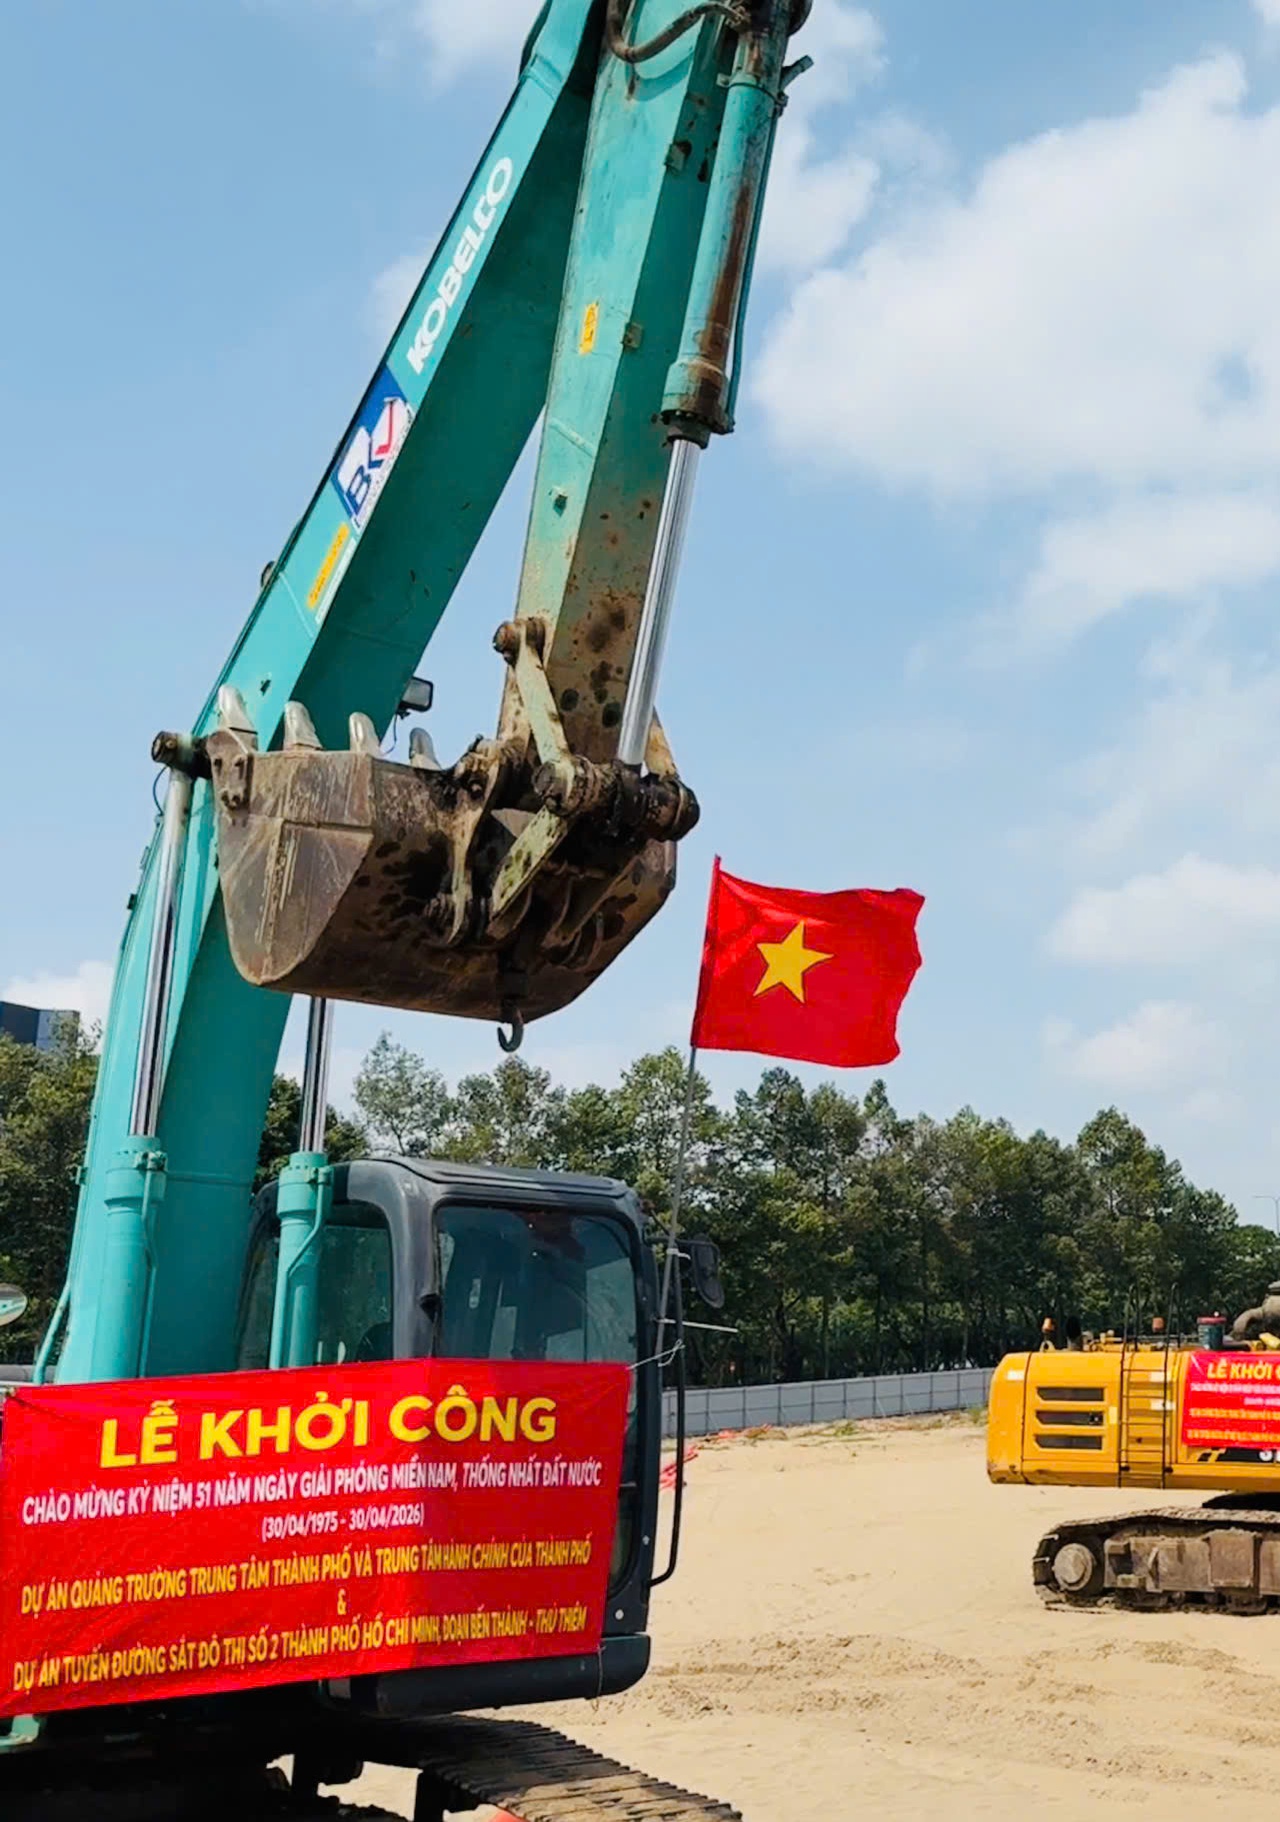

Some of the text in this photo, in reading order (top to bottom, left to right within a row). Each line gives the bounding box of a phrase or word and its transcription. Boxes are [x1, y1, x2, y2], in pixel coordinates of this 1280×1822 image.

[406, 157, 513, 375] KOBELCO
[100, 1384, 557, 1468] LỄ KHỞI CÔNG
[22, 1488, 70, 1525] CHÀO
[73, 1484, 125, 1519] MỪNG
[152, 1477, 193, 1517] NIỆM
[195, 1482, 212, 1508] 51
[214, 1472, 250, 1505] NĂM
[254, 1468, 298, 1502] NGÀY
[300, 1463, 332, 1498] GIẢI
[334, 1460, 389, 1494] PHÓNG
[391, 1453, 426, 1489] MIỀN
[428, 1462, 458, 1492] NAM,
[463, 1453, 506, 1488] THỐNG
[508, 1453, 541, 1488] NHẤT
[542, 1453, 568, 1487] ĐẤT
[568, 1456, 602, 1487] NƯỚC
[261, 1511, 338, 1542] (30/04/1975
[349, 1503, 424, 1531] 30/04/2026)
[21, 1582, 45, 1619] DỰ
[46, 1577, 67, 1610] ÁN
[70, 1571, 123, 1608] QUẢNG
[125, 1565, 187, 1602] TRƯỜNG
[189, 1565, 237, 1596] TRUNG
[240, 1555, 270, 1590] TÂM
[272, 1551, 319, 1586] THÀNH
[322, 1543, 352, 1581] PHỐ
[354, 1543, 372, 1577] VÀ
[375, 1545, 419, 1575] TRUNG
[421, 1538, 442, 1570] TÂM
[472, 1535, 510, 1569] CHÍNH
[510, 1534, 533, 1567] CỦA
[535, 1535, 569, 1566] THÀNH
[569, 1531, 592, 1565] PHỐ
[337, 1588, 347, 1615] &
[13, 1658, 37, 1695] DỰ
[38, 1652, 60, 1687] ÁN
[63, 1643, 109, 1683] TUYẾN
[112, 1641, 166, 1679] ĐƯỜNG
[169, 1634, 196, 1671] SẮT
[198, 1633, 220, 1668] ĐÔ
[223, 1636, 246, 1669] THỊ
[247, 1623, 270, 1663] SỐ
[270, 1634, 279, 1660] 2
[281, 1623, 328, 1659] THÀNH
[331, 1613, 361, 1651] PHỐ
[385, 1611, 409, 1647] CHÍ
[491, 1604, 528, 1637] THÀNH
[536, 1602, 558, 1634] THỦ
